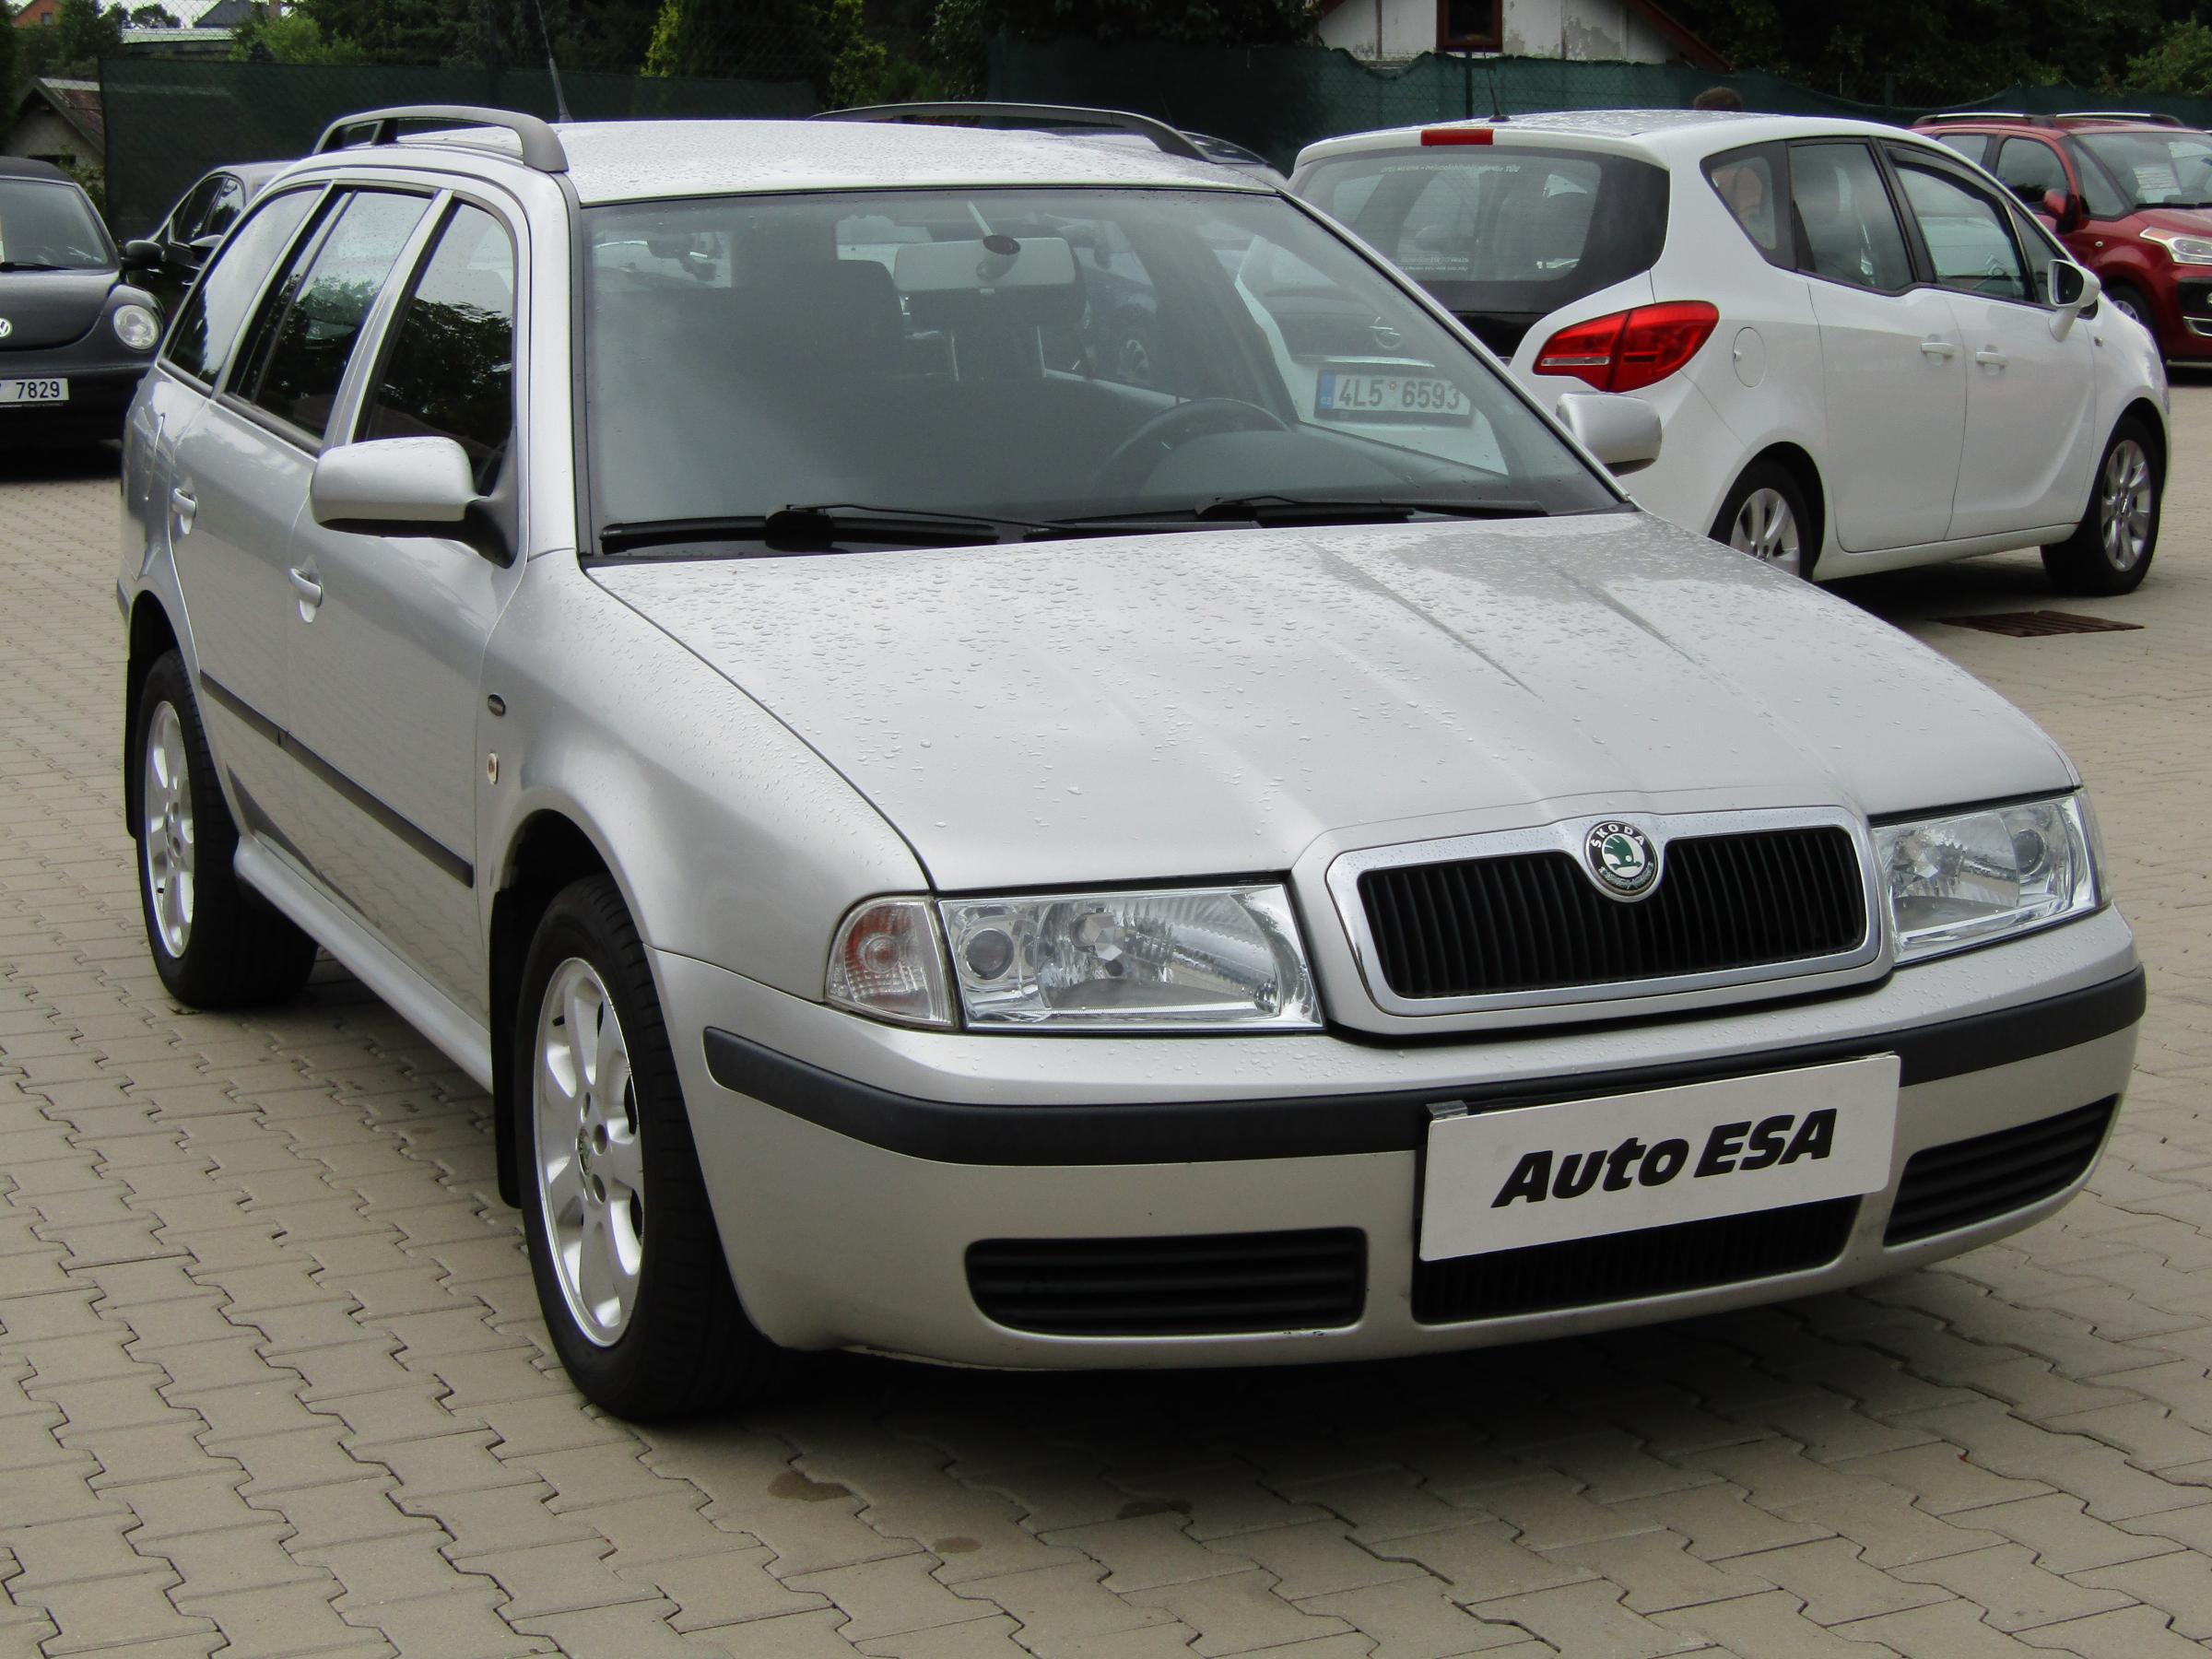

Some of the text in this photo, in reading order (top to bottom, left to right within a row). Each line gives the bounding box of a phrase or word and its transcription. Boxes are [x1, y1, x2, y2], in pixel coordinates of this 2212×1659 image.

[16, 381, 61, 399] 7829
[1338, 379, 1461, 410] 4L5 6593
[1590, 823, 1646, 849] ŠKODA
[1490, 1108, 1837, 1208] Auto ESA
